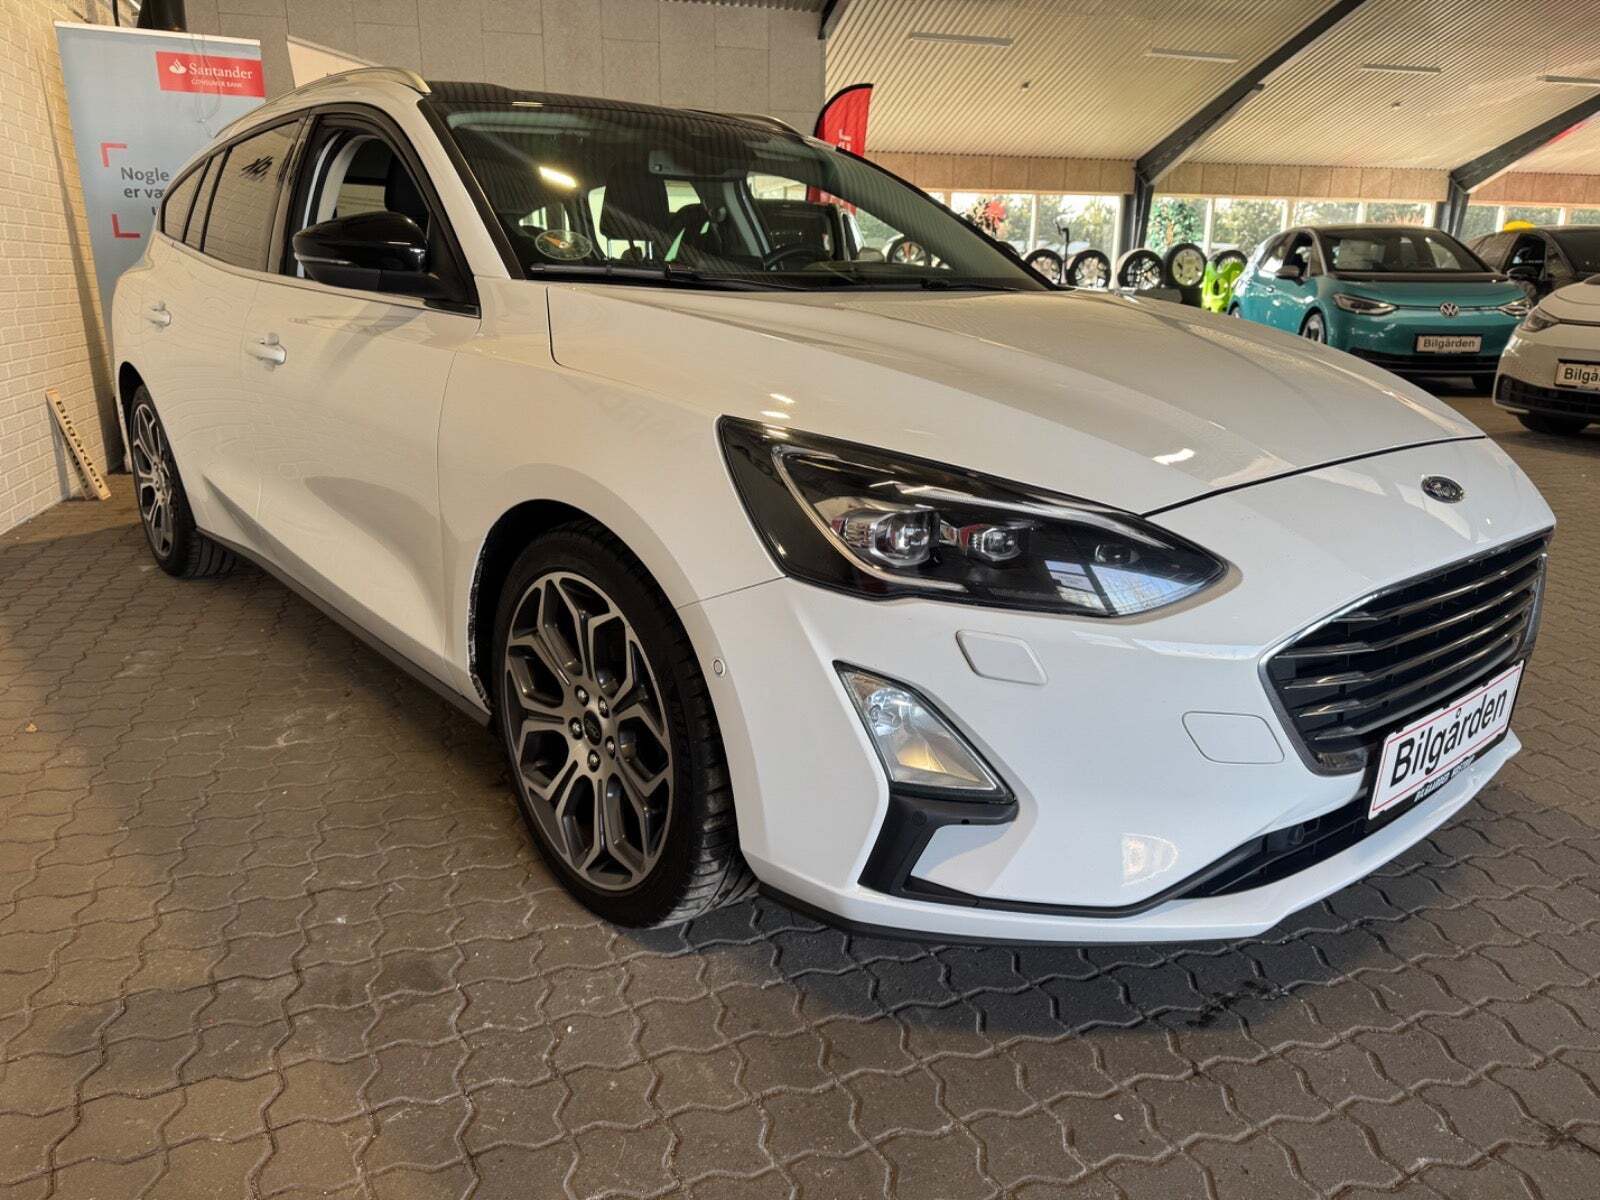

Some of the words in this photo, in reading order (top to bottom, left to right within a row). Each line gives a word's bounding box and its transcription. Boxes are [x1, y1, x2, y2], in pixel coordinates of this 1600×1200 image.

[188, 62, 253, 79] Santander
[120, 166, 170, 184] Nogle
[123, 187, 140, 198] er
[1423, 338, 1476, 350] Bilgården
[1563, 367, 1600, 385] Bilgå
[1390, 689, 1508, 788] Bilgården
